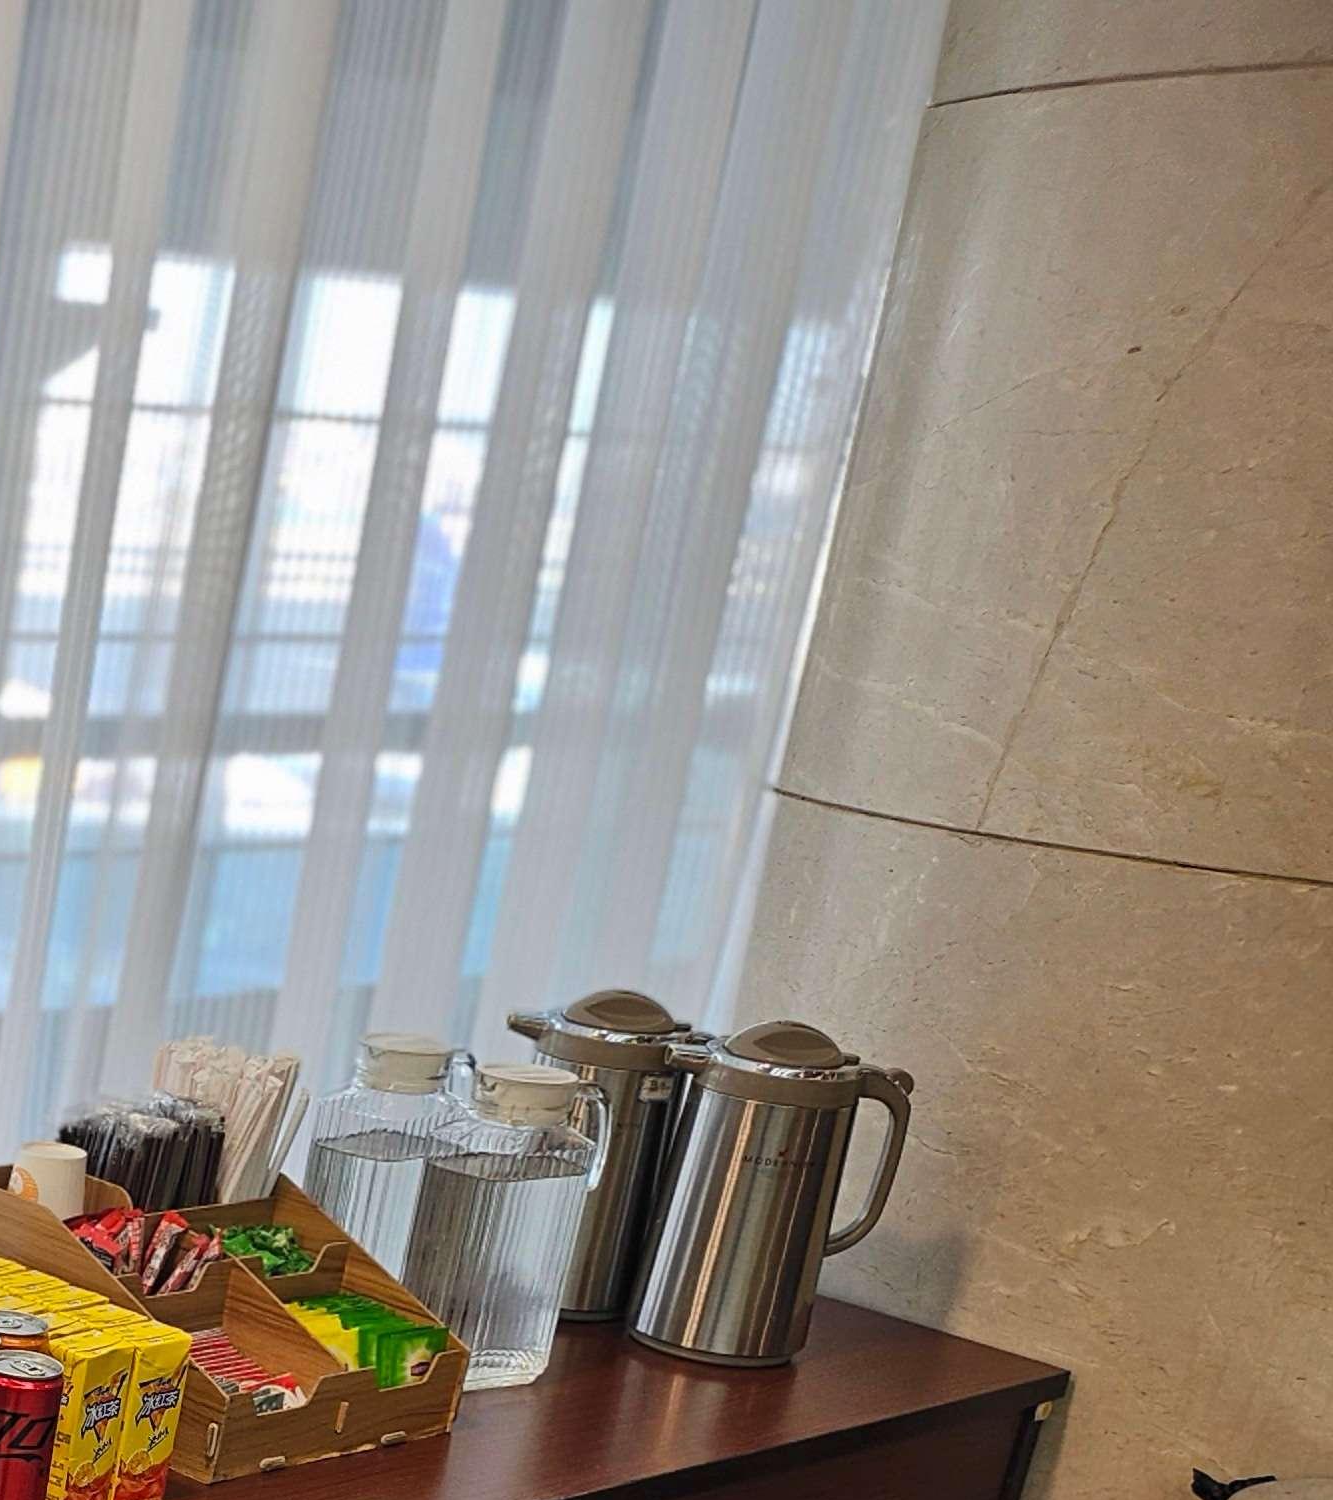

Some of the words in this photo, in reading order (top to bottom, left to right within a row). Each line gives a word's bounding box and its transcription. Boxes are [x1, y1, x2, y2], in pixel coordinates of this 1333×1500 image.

[83, 1398, 122, 1434] 冰红茶
[138, 1389, 182, 1422] 冰红茶
